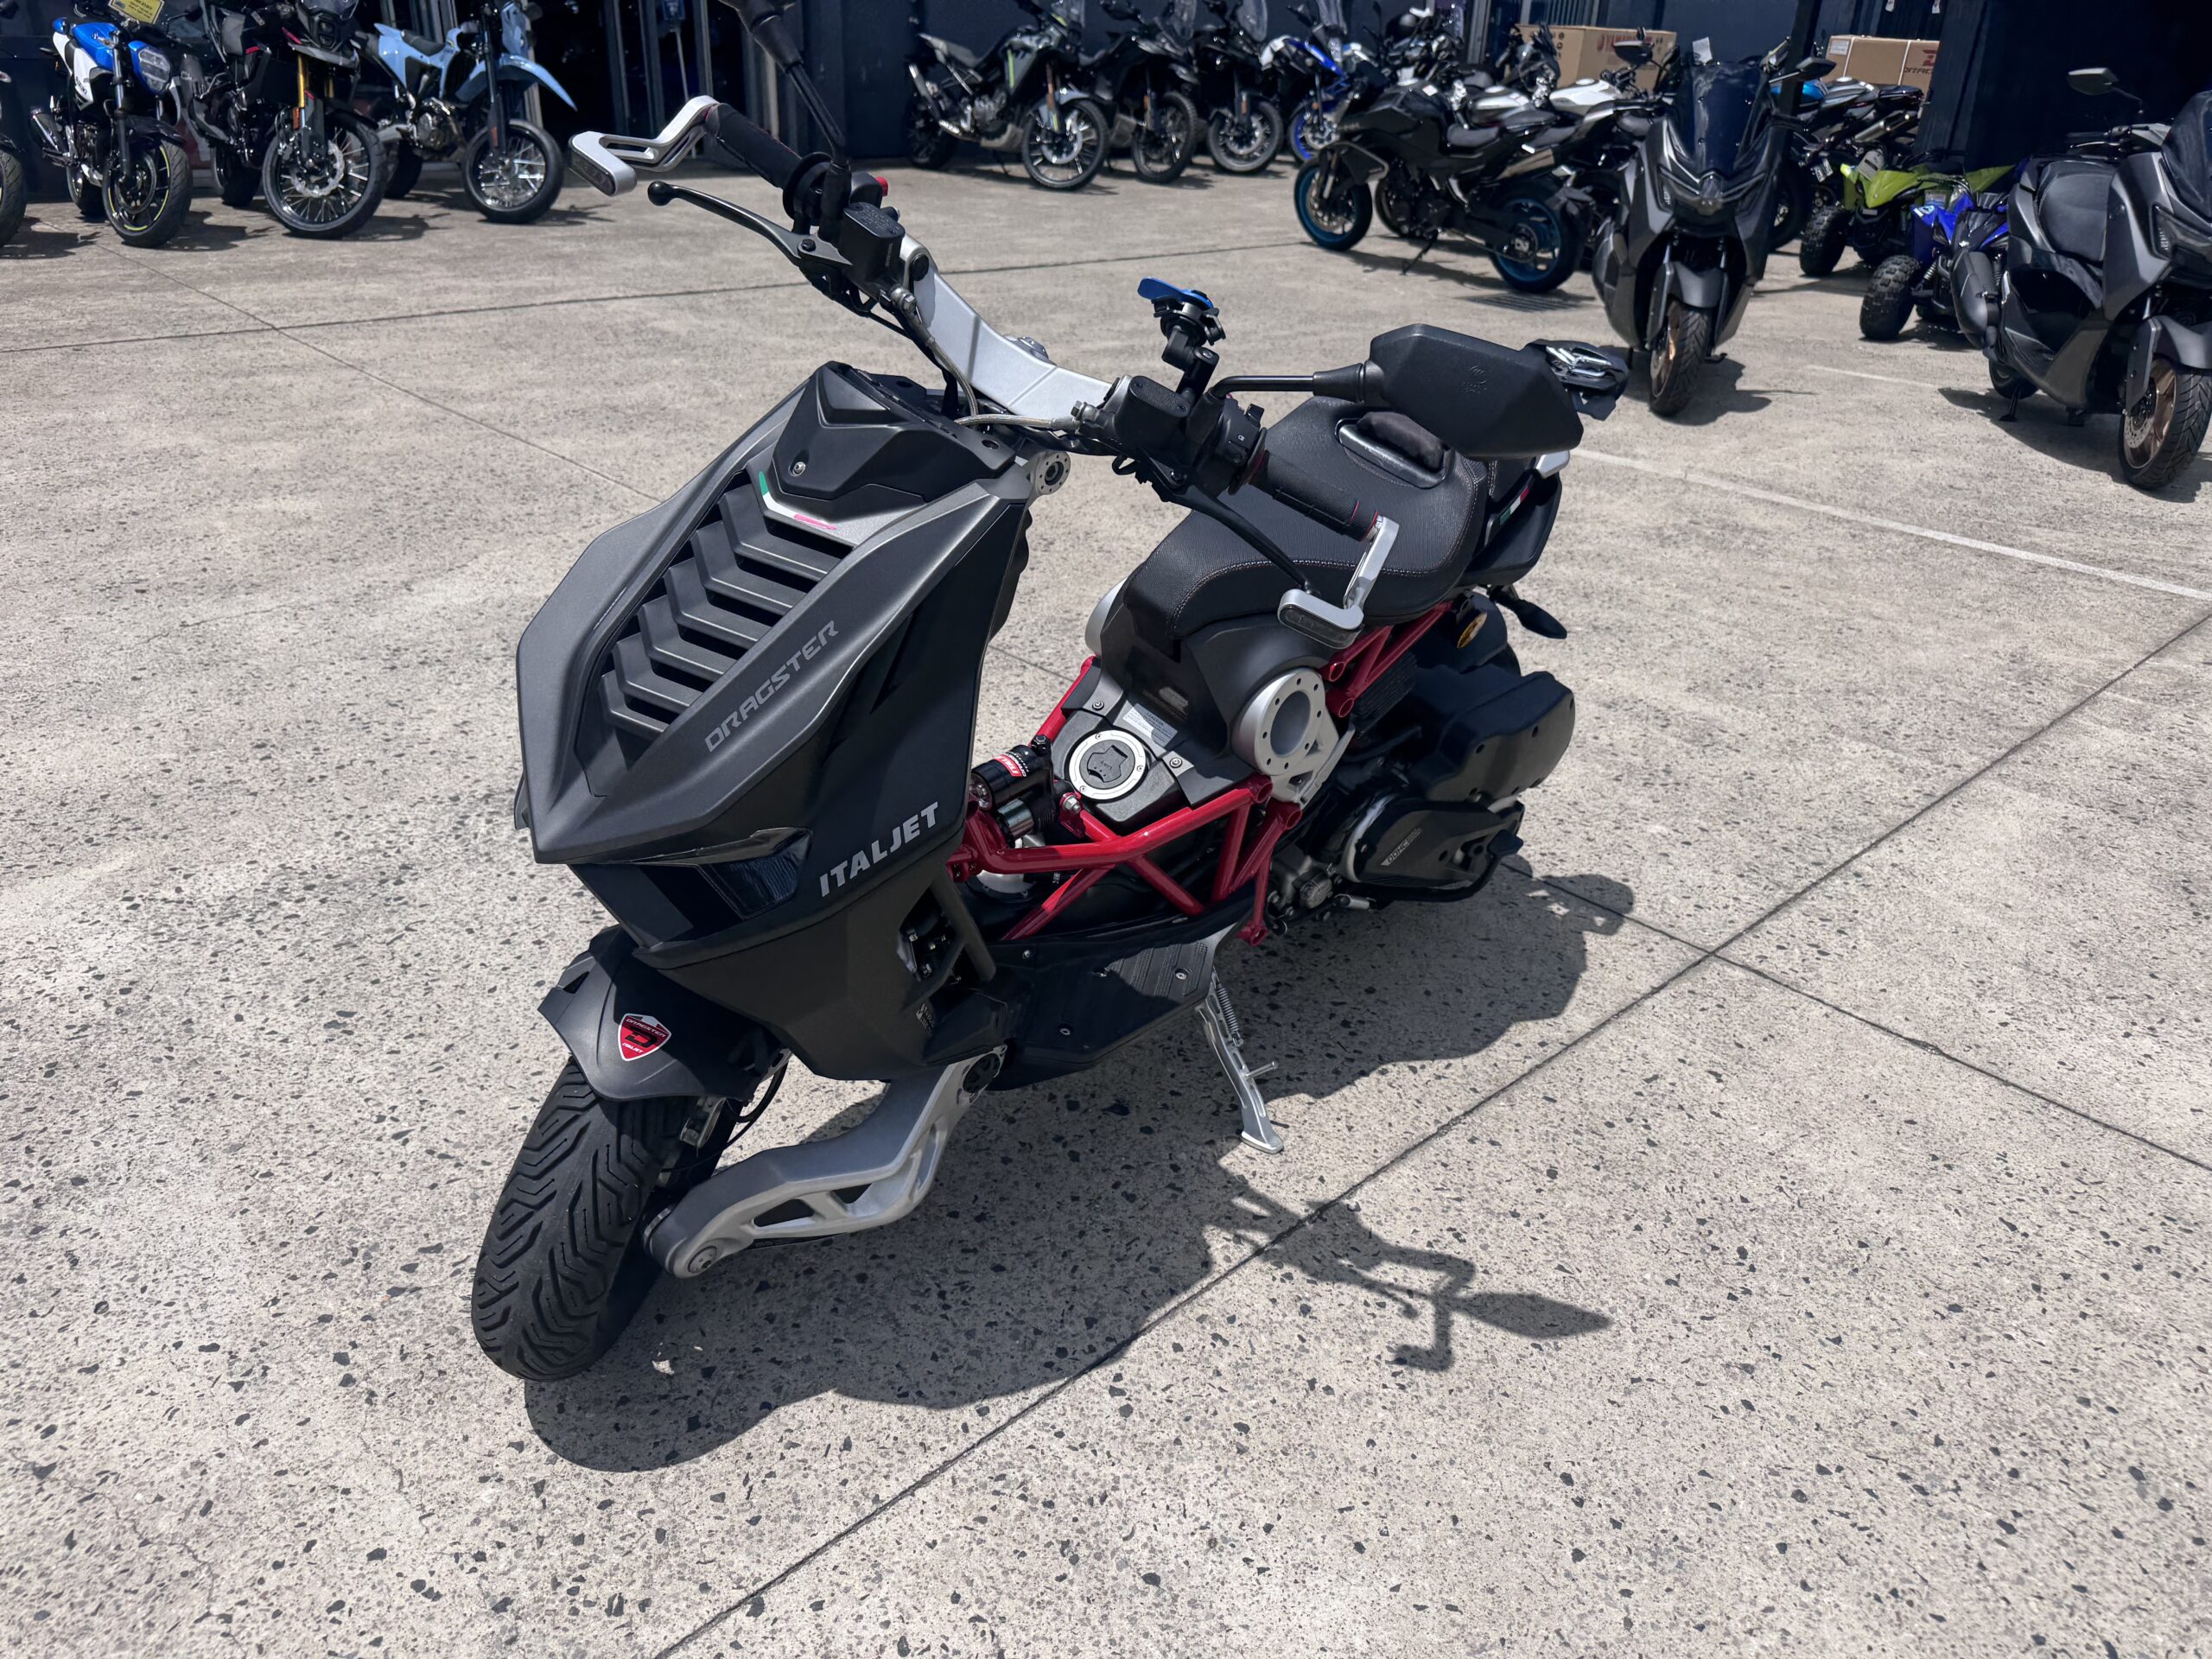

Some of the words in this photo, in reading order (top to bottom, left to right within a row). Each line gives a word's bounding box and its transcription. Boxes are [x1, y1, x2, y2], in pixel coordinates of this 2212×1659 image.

[704, 620, 838, 753] DRAGSTER
[820, 801, 938, 898] ITALJET
[622, 1042, 644, 1052] ITALJET
[626, 1018, 666, 1038] DRAGSTER
